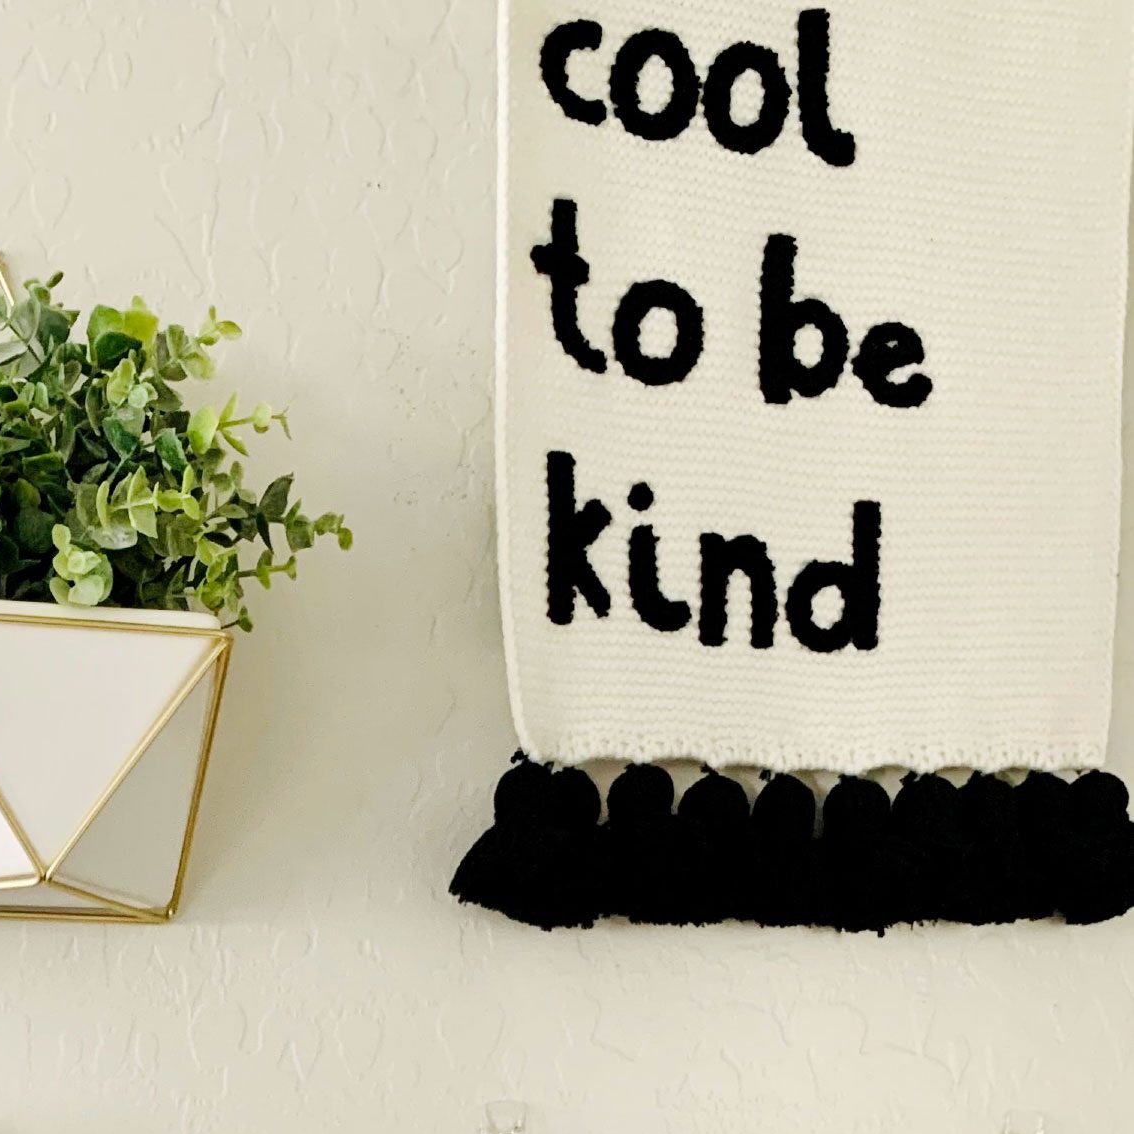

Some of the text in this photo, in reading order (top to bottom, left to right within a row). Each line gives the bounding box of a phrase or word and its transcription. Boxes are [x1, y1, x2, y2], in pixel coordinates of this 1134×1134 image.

[538, 8, 857, 168] cool
[529, 197, 933, 409] to be
[544, 450, 882, 654] kind
